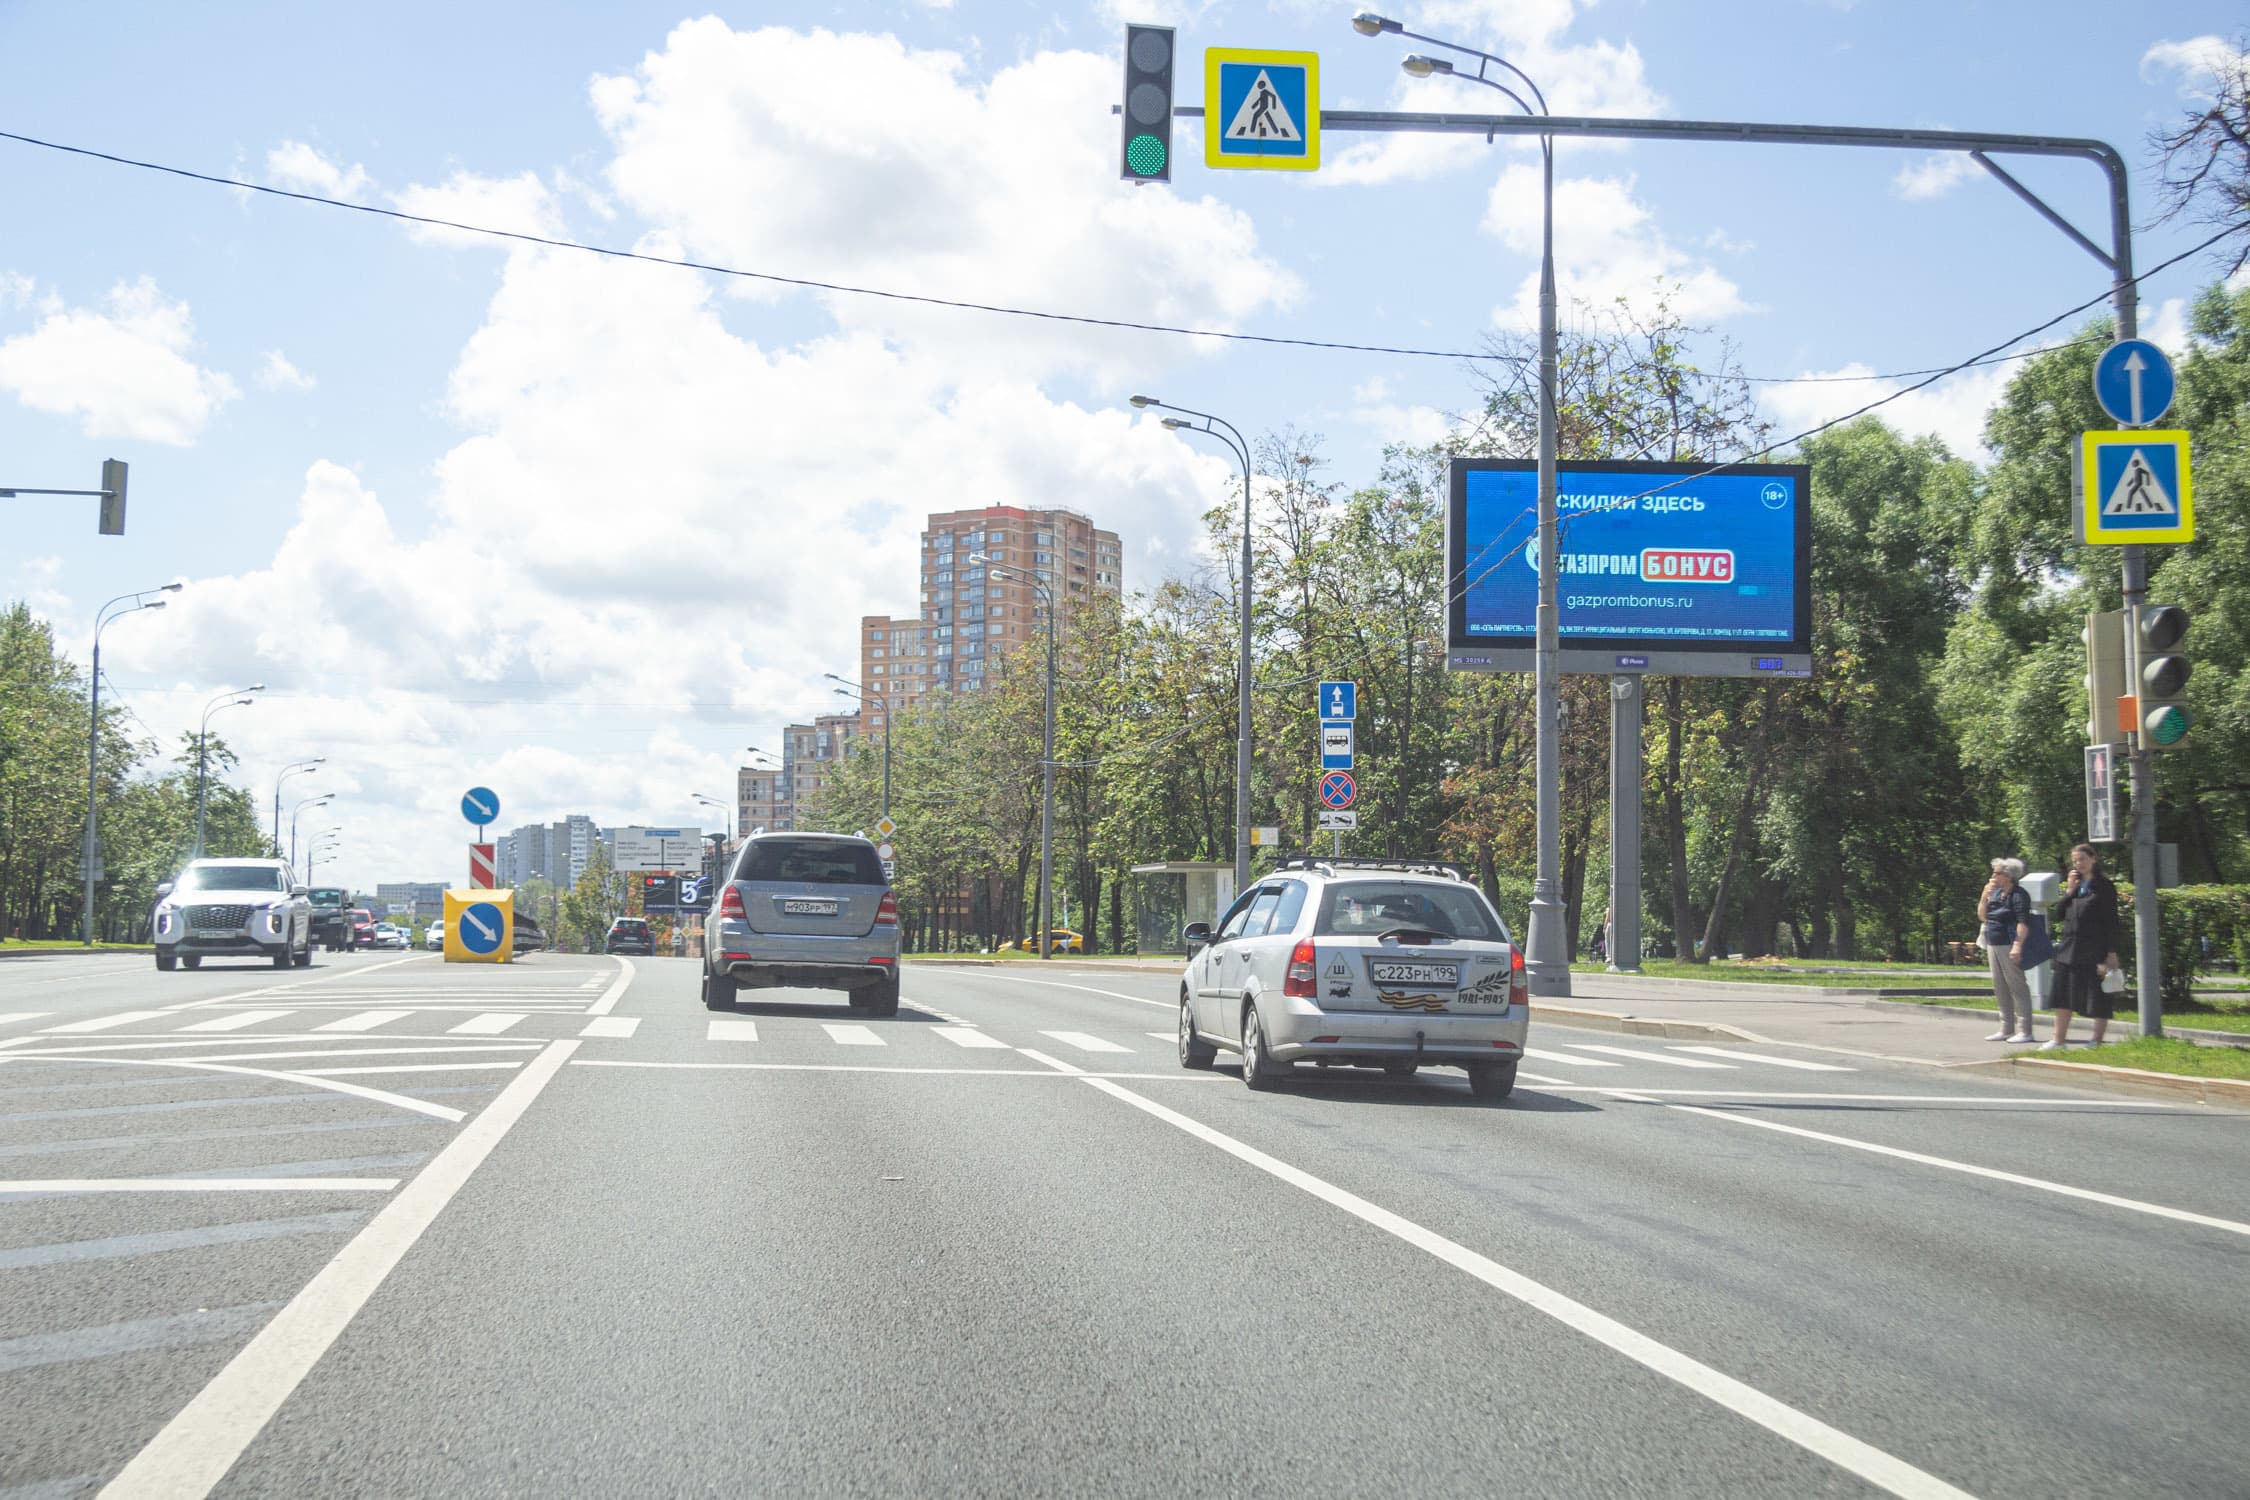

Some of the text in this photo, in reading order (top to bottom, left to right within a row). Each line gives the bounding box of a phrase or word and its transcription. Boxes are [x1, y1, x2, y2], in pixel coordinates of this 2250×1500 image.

[1765, 491, 1784, 501] 18+
[1555, 494, 1705, 513] СКИДКИ ЗДЕСЬ
[1558, 554, 1728, 577] ГАЗПРОМ БОНУС
[1566, 595, 1693, 609] gazprombonus.ru
[1333, 965, 1345, 975] Ш
[1458, 993, 1505, 1005] 1941-1945
